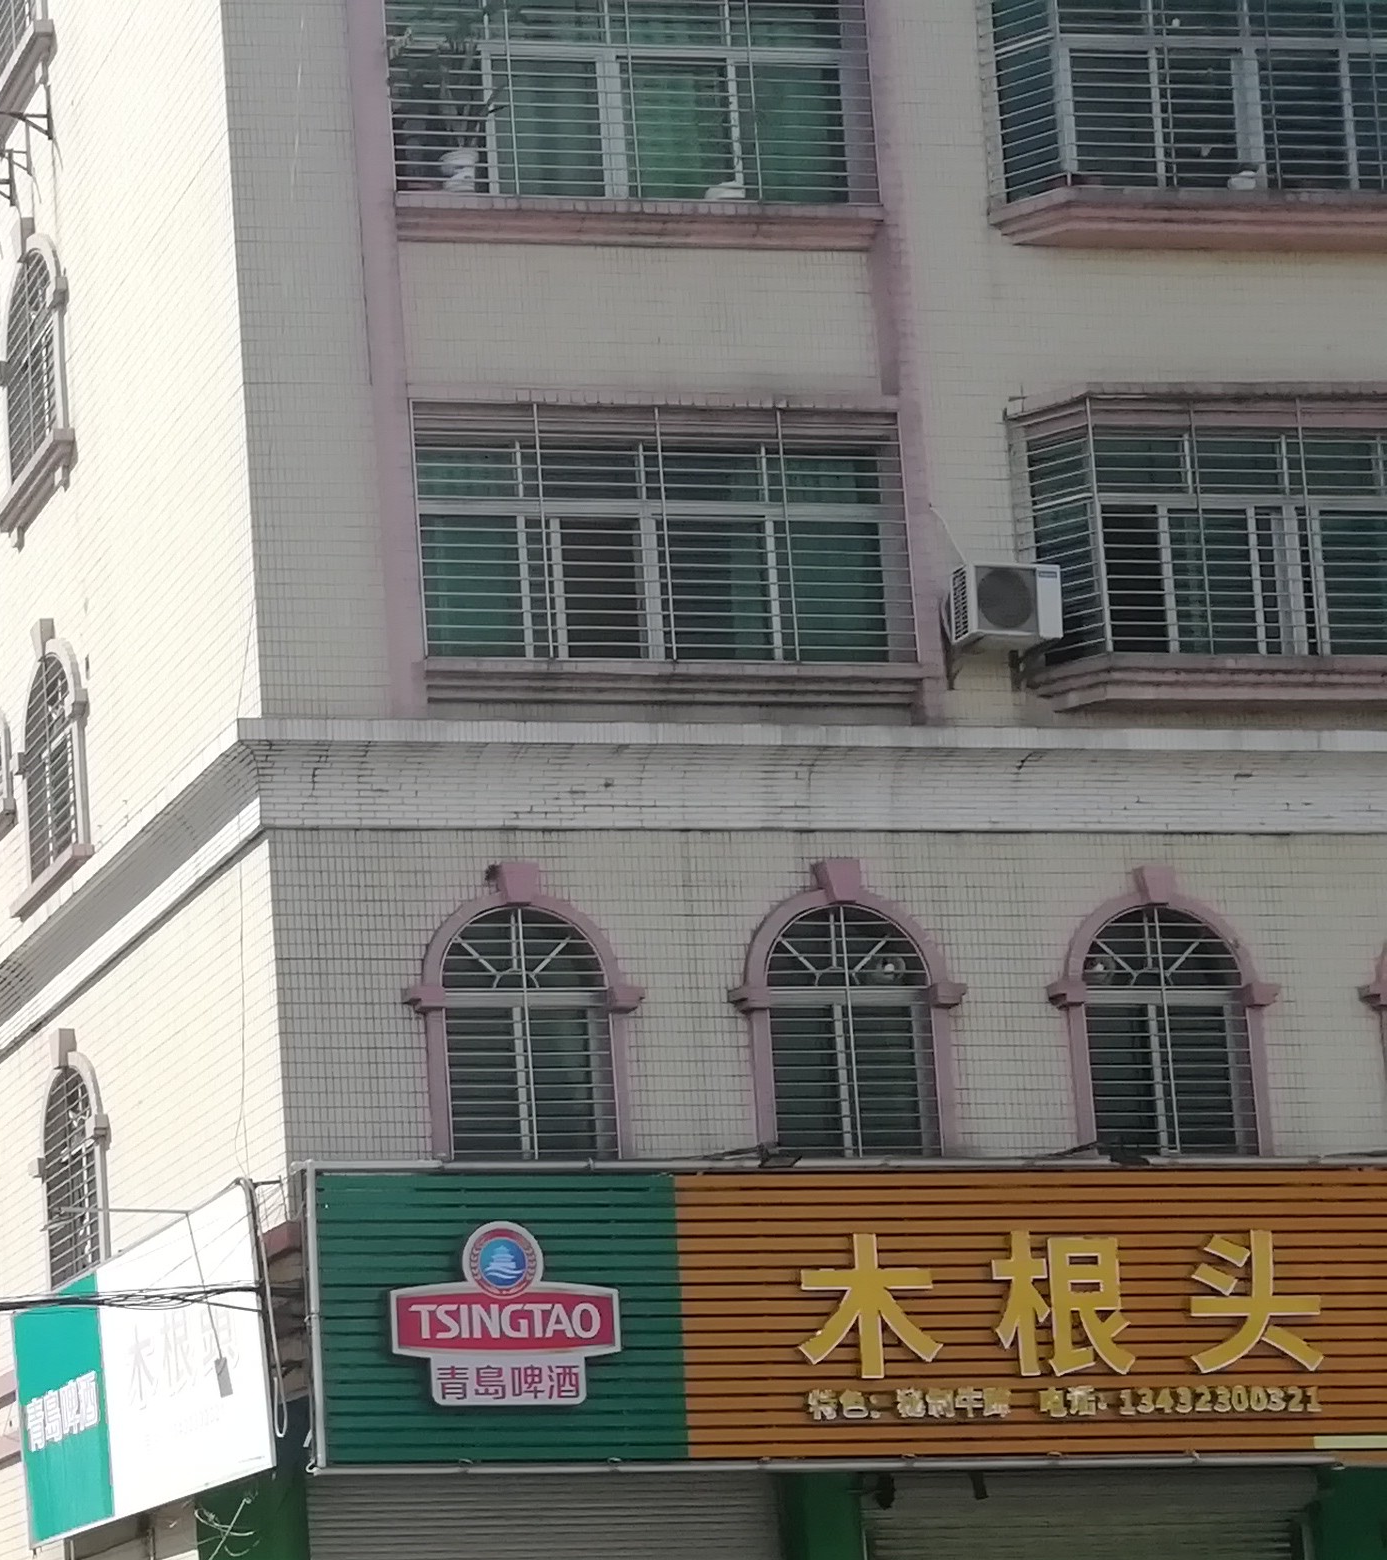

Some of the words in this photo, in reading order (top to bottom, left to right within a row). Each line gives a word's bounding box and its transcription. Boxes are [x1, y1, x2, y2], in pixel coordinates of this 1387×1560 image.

[409, 1302, 601, 1340] TSINGTAO
[798, 1230, 1323, 1378] 木根头
[436, 1365, 581, 1400] 青島啤酒
